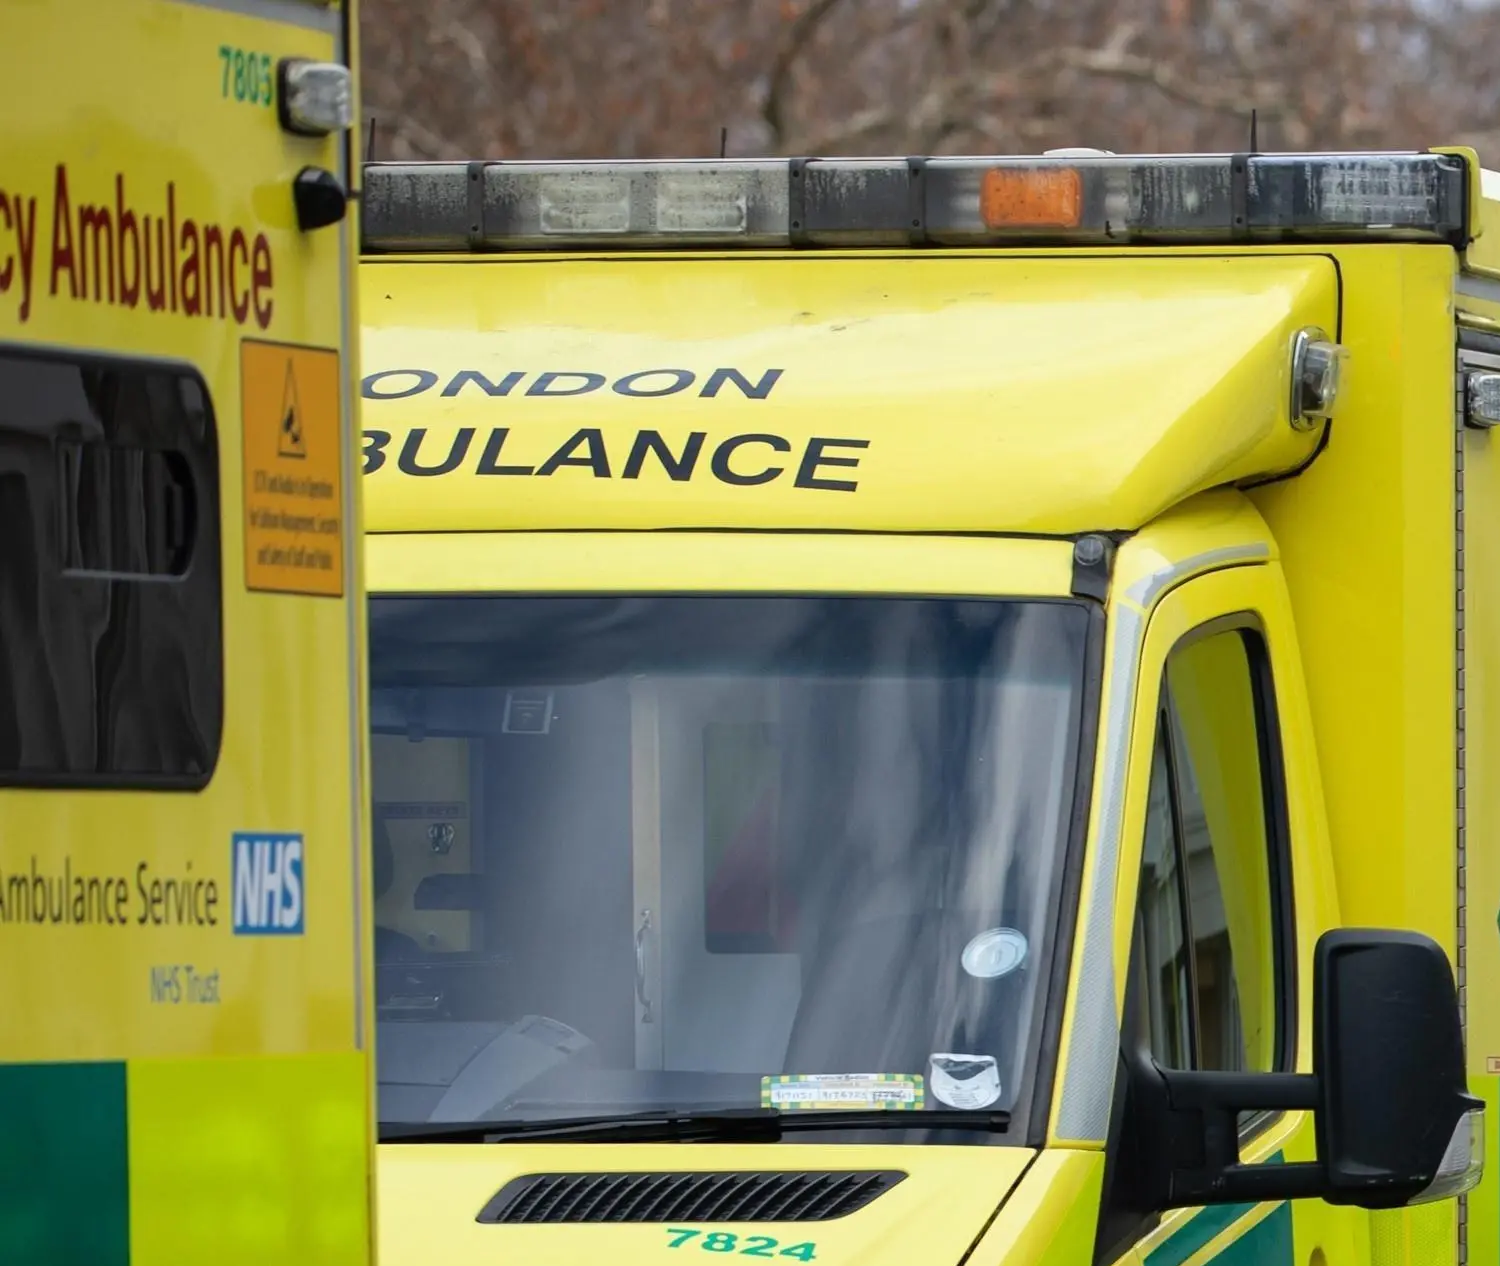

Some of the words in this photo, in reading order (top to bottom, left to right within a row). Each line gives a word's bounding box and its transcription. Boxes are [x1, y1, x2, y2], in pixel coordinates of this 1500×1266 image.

[219, 46, 272, 106] 7805
[50, 163, 273, 330] Ambulance
[136, 861, 218, 927] Service
[234, 839, 303, 930] NHS
[150, 966, 181, 1004] NHS
[185, 966, 220, 1004] Trust
[665, 1227, 818, 1263] 7824
